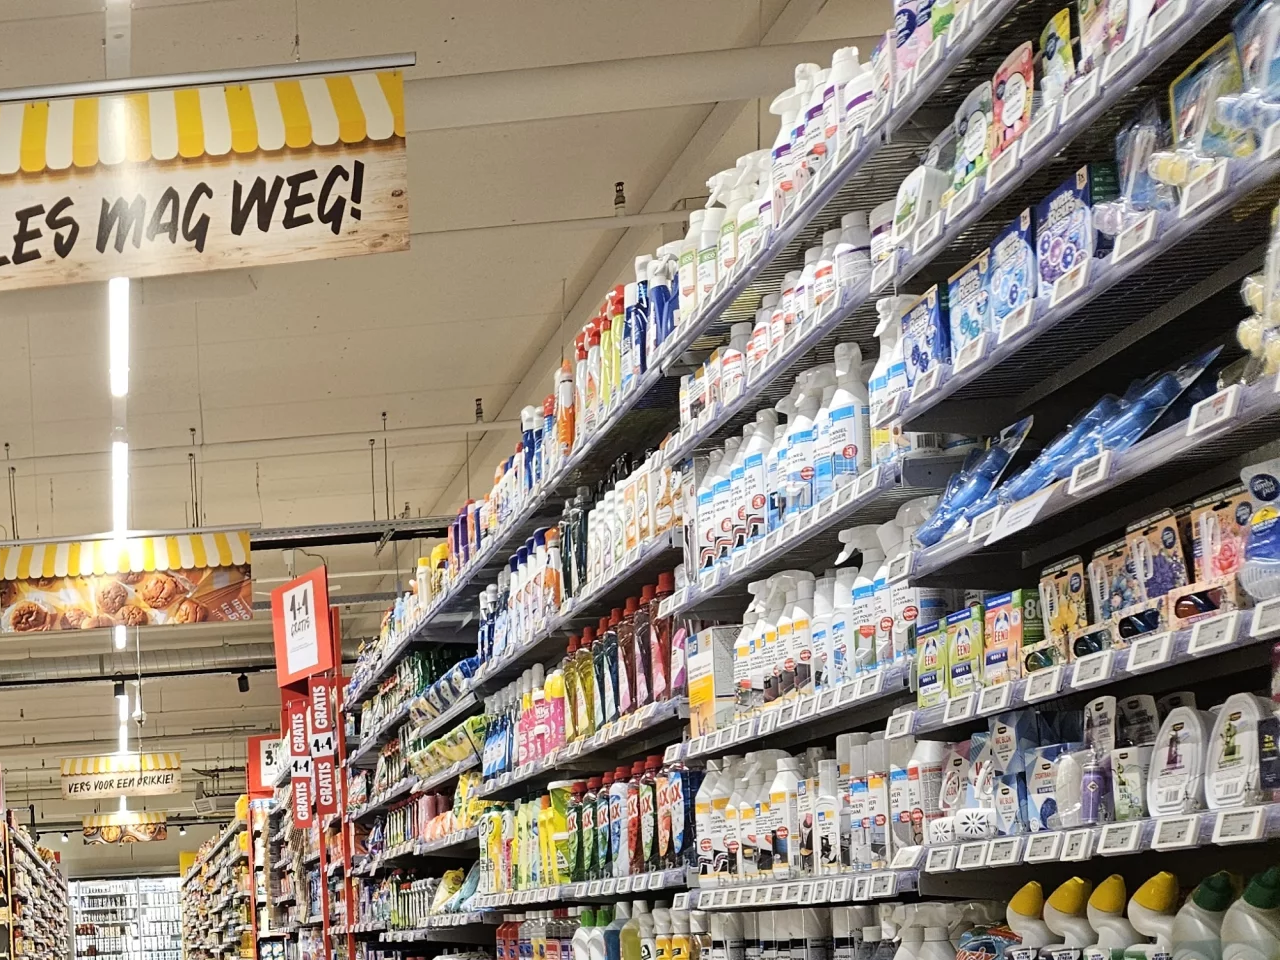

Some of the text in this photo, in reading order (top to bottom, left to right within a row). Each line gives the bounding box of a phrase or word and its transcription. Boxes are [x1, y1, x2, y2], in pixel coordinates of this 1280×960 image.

[95, 180, 213, 255] MAG
[230, 160, 366, 237] WEG!
[289, 588, 309, 621] 1+1
[290, 616, 310, 638] GRATIS
[312, 684, 329, 729] GRATIS
[292, 712, 306, 753] GRATIS
[313, 737, 332, 753] 1+1
[68, 773, 174, 793] VERS VOOR EEN PRIKKIE!
[292, 760, 310, 773] 1+1
[317, 761, 334, 806] GRATIS
[295, 781, 310, 821] GRATIS
